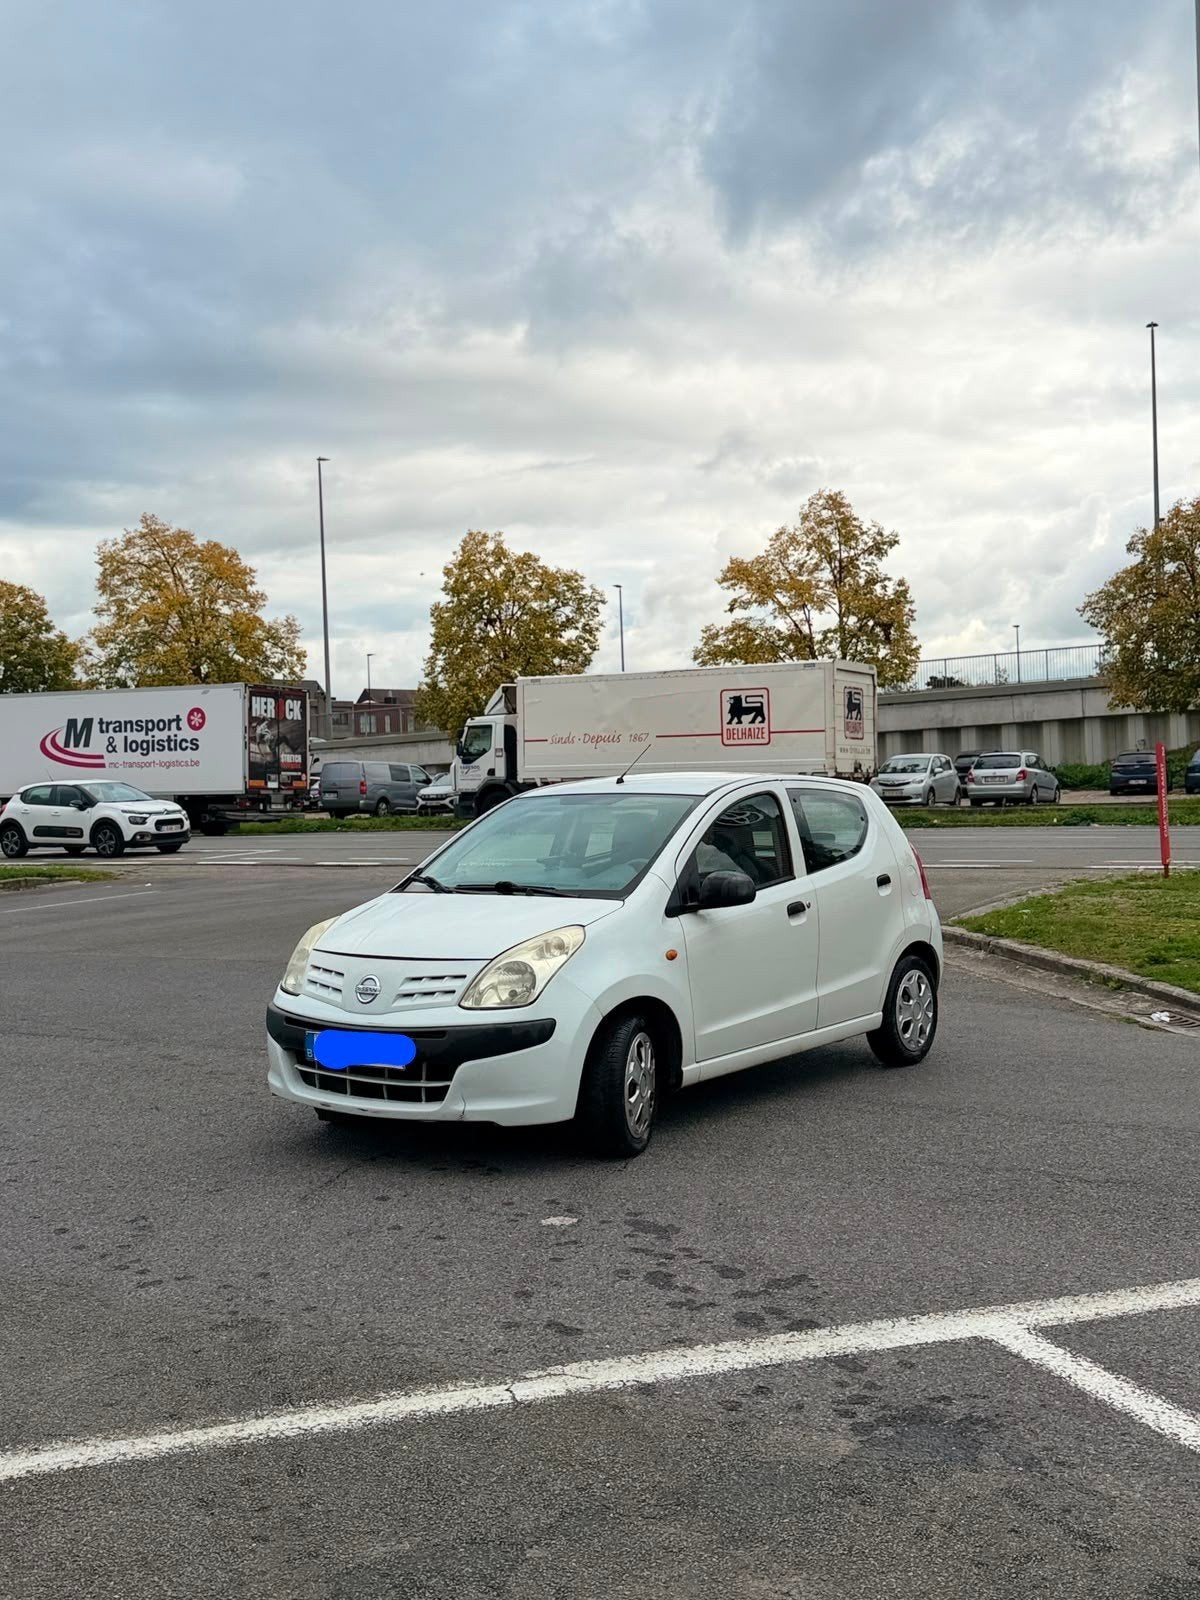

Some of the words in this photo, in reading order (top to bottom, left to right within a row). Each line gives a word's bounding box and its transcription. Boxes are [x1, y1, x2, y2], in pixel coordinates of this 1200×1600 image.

[98, 714, 182, 736] transport
[583, 730, 622, 749] Depuis
[628, 732, 650, 743] 1867
[726, 727, 766, 740] DELHAIZE
[106, 736, 118, 753] &
[123, 734, 199, 756] logistics
[108, 759, 200, 770] mc-transport-logistics.be
[306, 1048, 313, 1058] B
